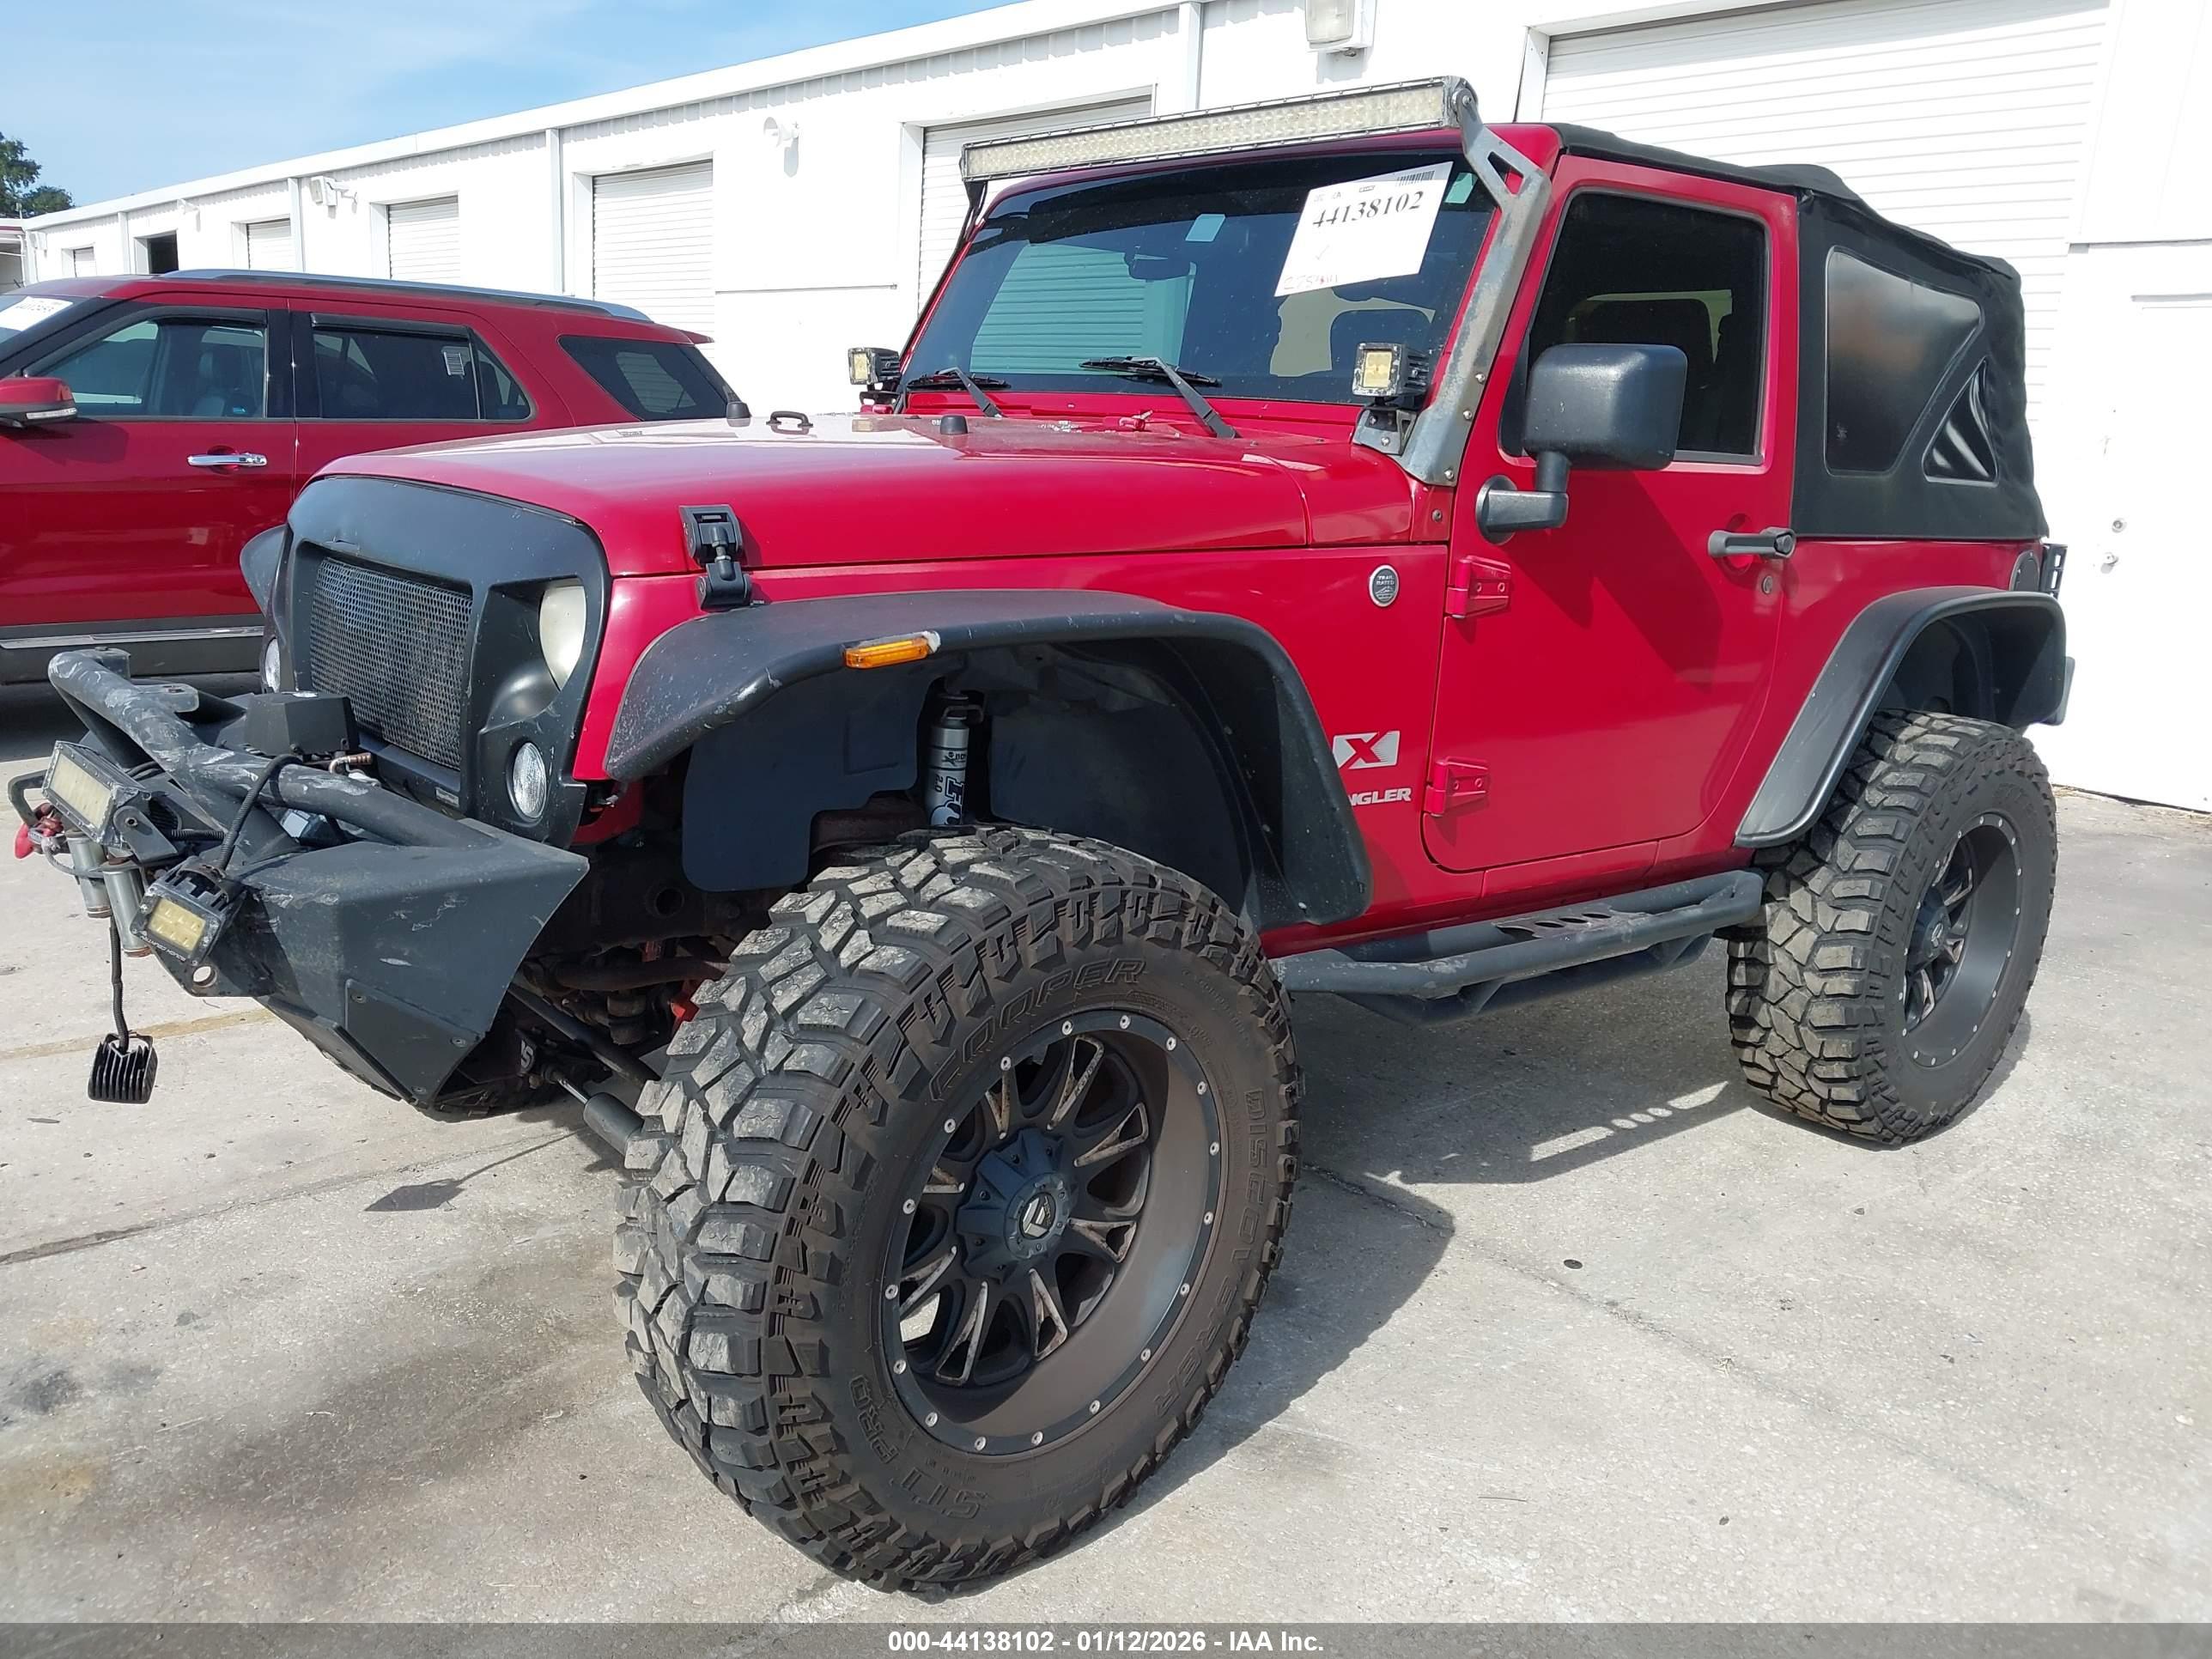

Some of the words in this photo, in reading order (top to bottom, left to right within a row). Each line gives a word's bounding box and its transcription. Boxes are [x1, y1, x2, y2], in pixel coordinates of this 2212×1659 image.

[1313, 190, 1424, 228] 44138102
[934, 774, 944, 793] 2.0
[140, 935, 167, 951] COUNTRY
[166, 949, 186, 962] ROUGH
[929, 957, 1147, 1101] COOPER
[1153, 1087, 1267, 1419] DISCOVERER
[848, 1374, 900, 1464] PRO
